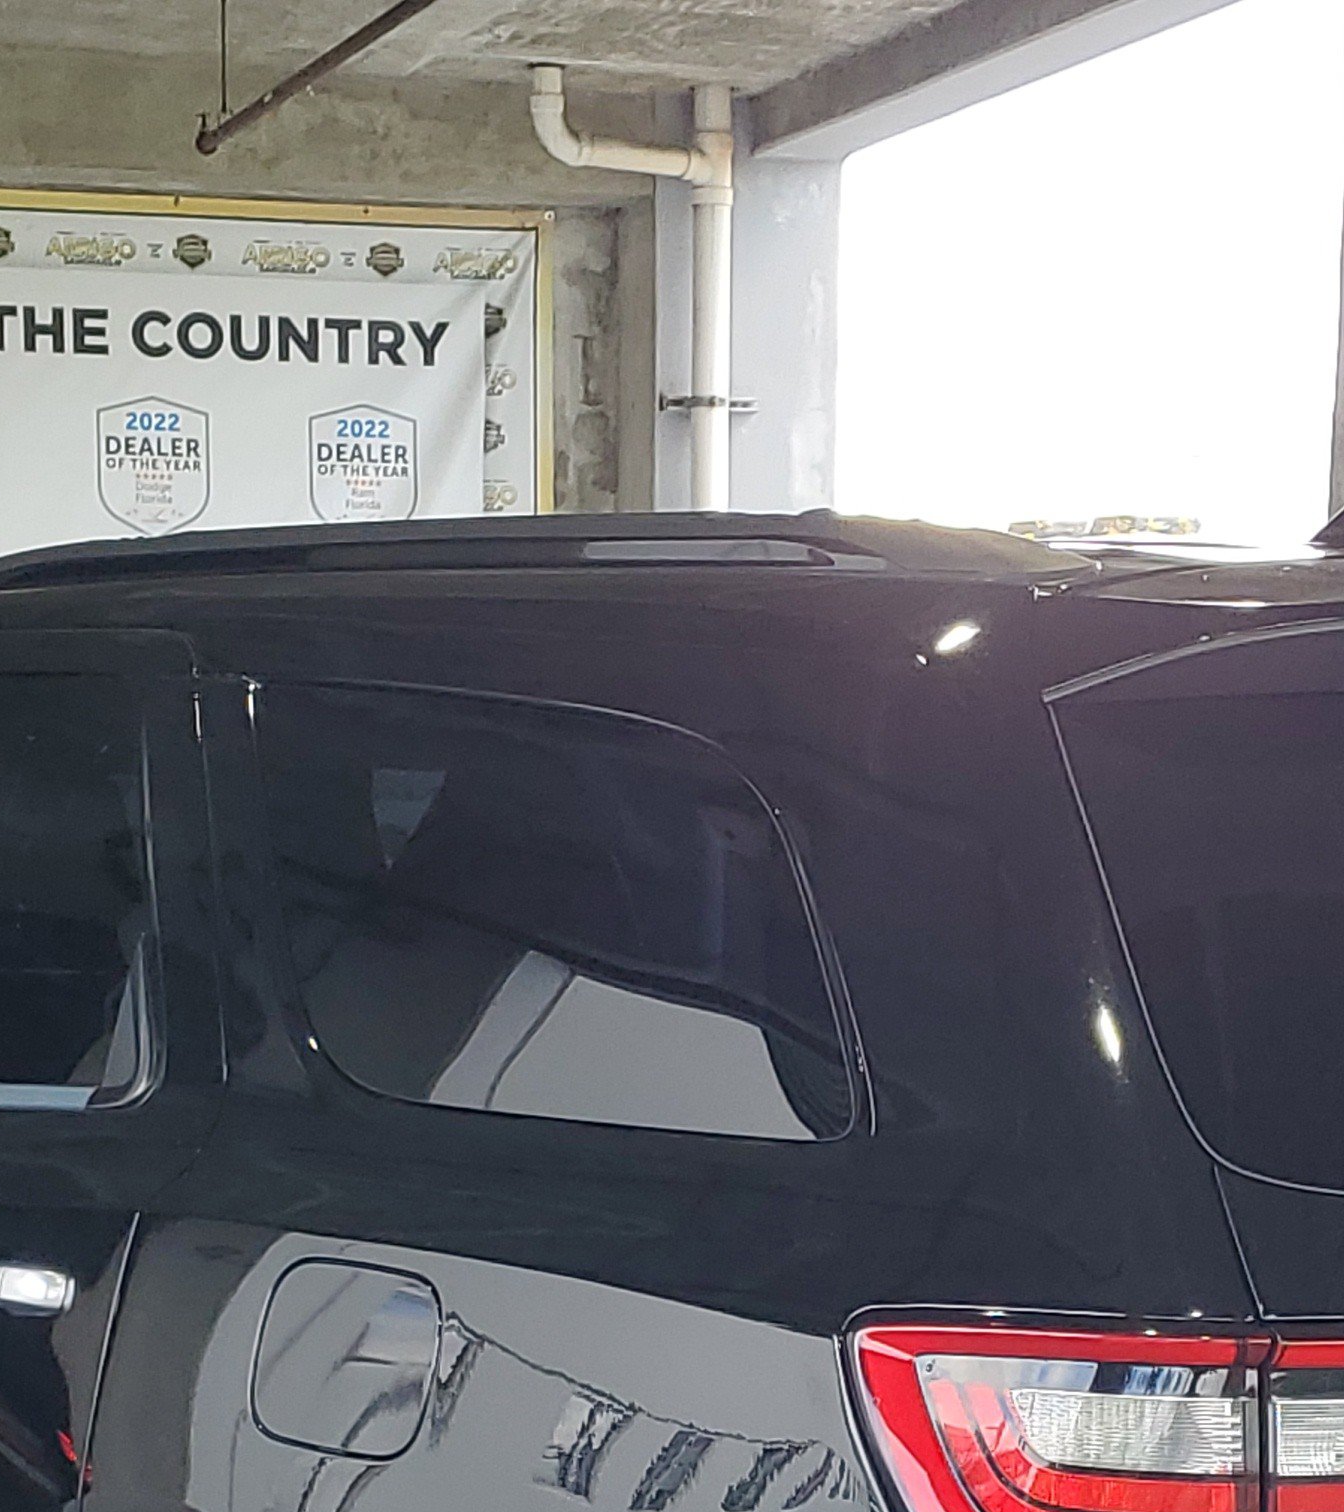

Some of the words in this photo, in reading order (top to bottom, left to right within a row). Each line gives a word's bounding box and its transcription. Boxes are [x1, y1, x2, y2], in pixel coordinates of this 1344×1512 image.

[131, 310, 449, 367] COUNTRY
[125, 412, 181, 432] 2022
[336, 419, 390, 439] 2022
[105, 436, 201, 458] DEALER
[316, 443, 409, 464] DEALER
[105, 458, 125, 470] OF
[130, 458, 159, 470] THE
[164, 459, 202, 472] YEAR
[317, 464, 337, 476] OF
[341, 464, 369, 477] THE
[373, 466, 409, 478] YEAR
